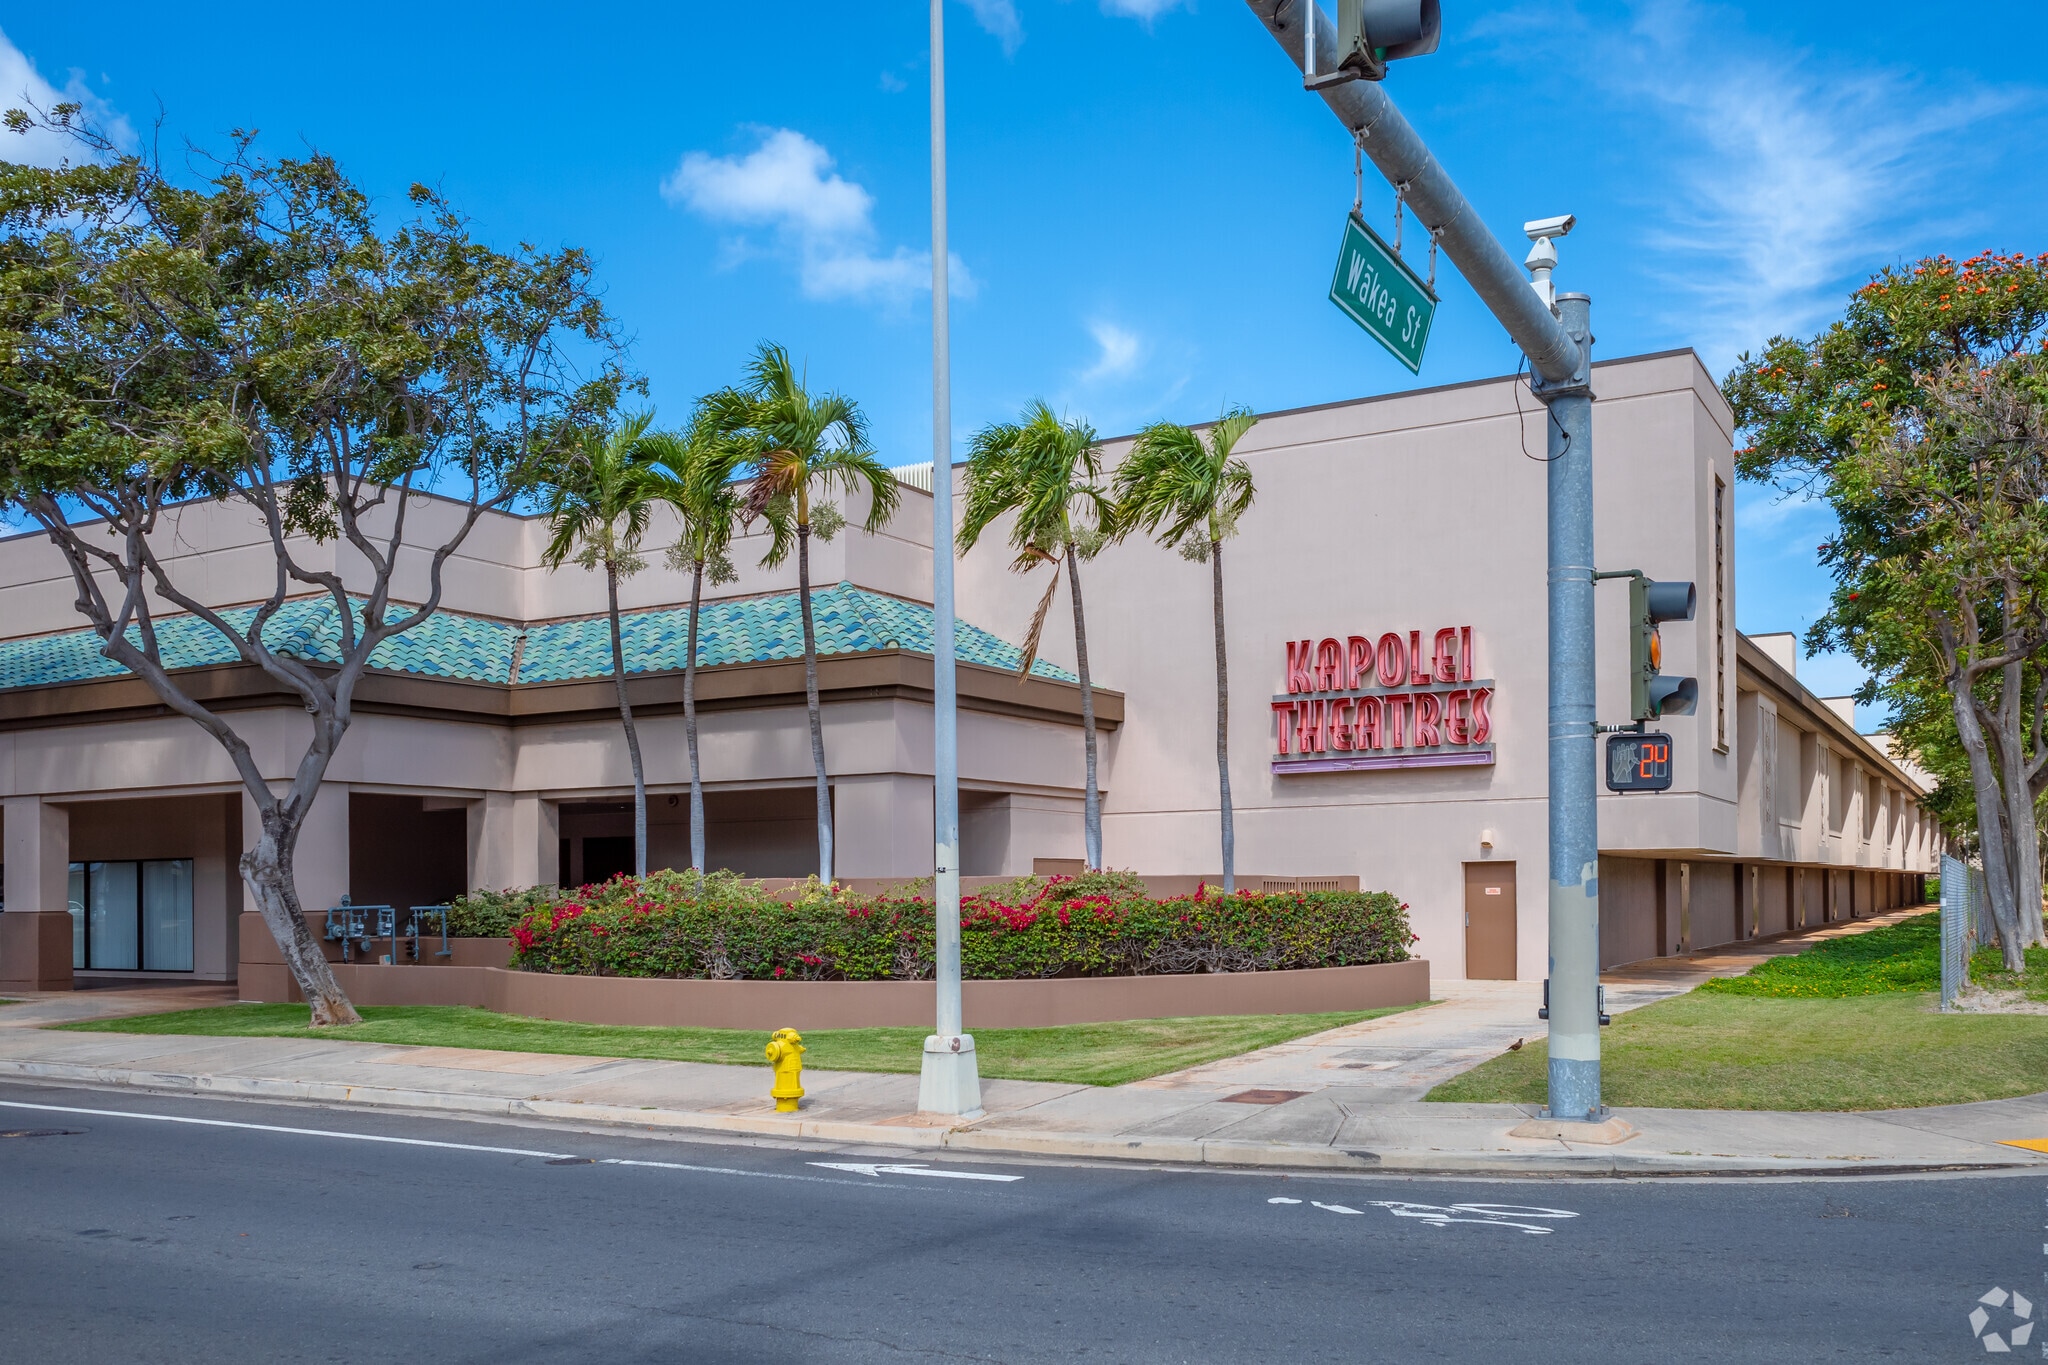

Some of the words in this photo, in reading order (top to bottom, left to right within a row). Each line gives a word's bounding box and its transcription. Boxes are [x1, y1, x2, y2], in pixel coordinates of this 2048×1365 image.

[1347, 249, 1397, 328] Wākea
[1402, 305, 1421, 349] St
[1286, 625, 1475, 694] KAPOLEI
[1271, 686, 1493, 755] THEATRES
[1639, 743, 1668, 778] 24
